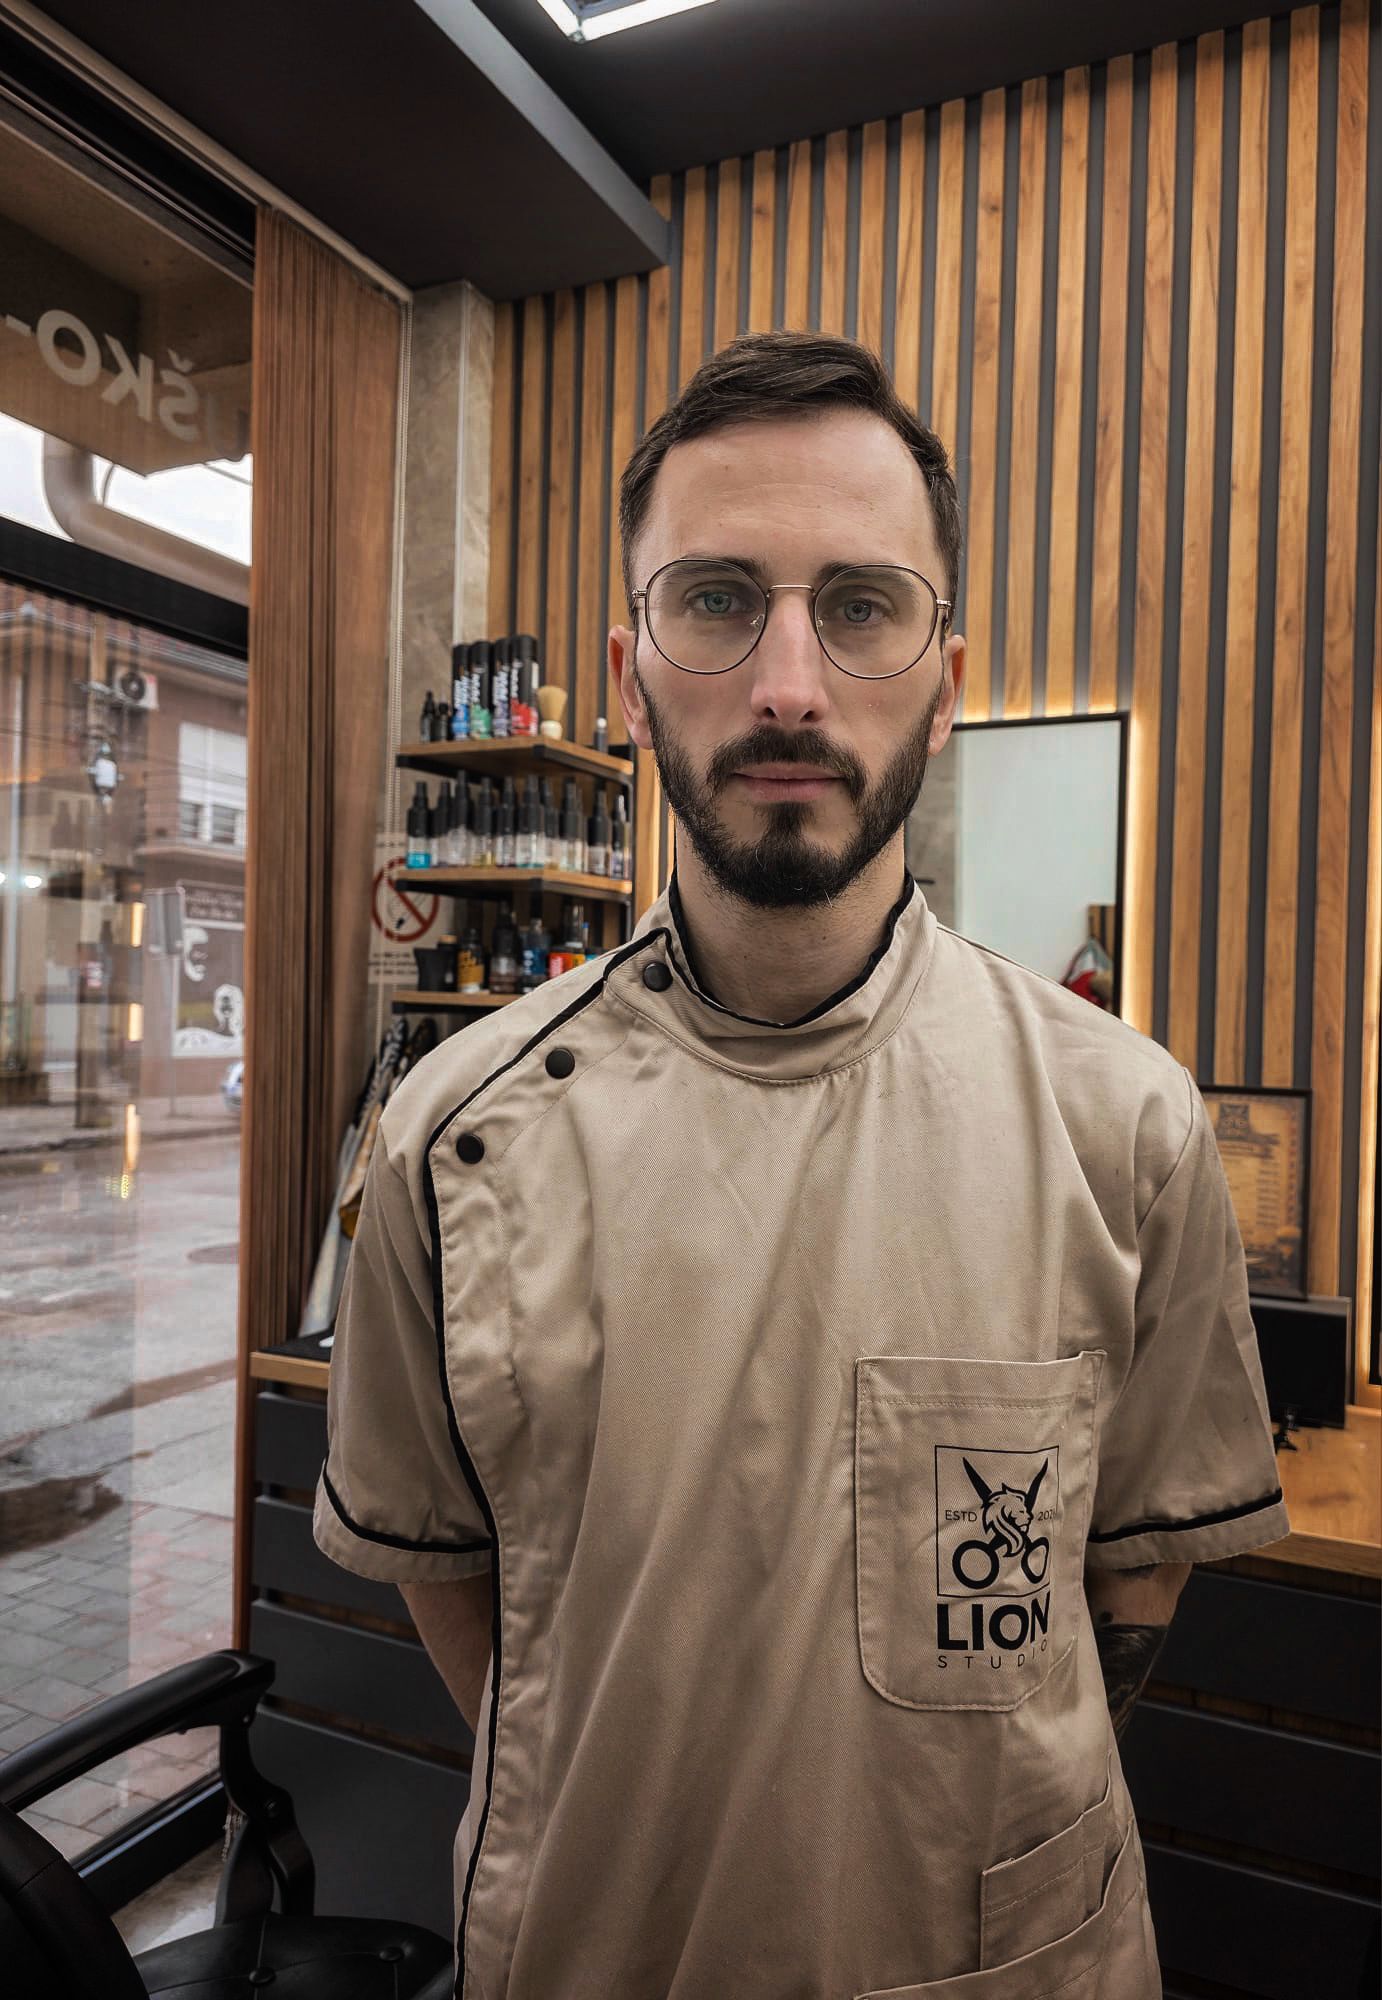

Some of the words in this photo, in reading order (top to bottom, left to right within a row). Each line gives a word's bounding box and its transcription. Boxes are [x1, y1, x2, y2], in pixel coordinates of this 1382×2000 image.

[944, 1509, 978, 1522] ESTD
[936, 1591, 1050, 1651] LION
[937, 1639, 1048, 1669] STUDIO
